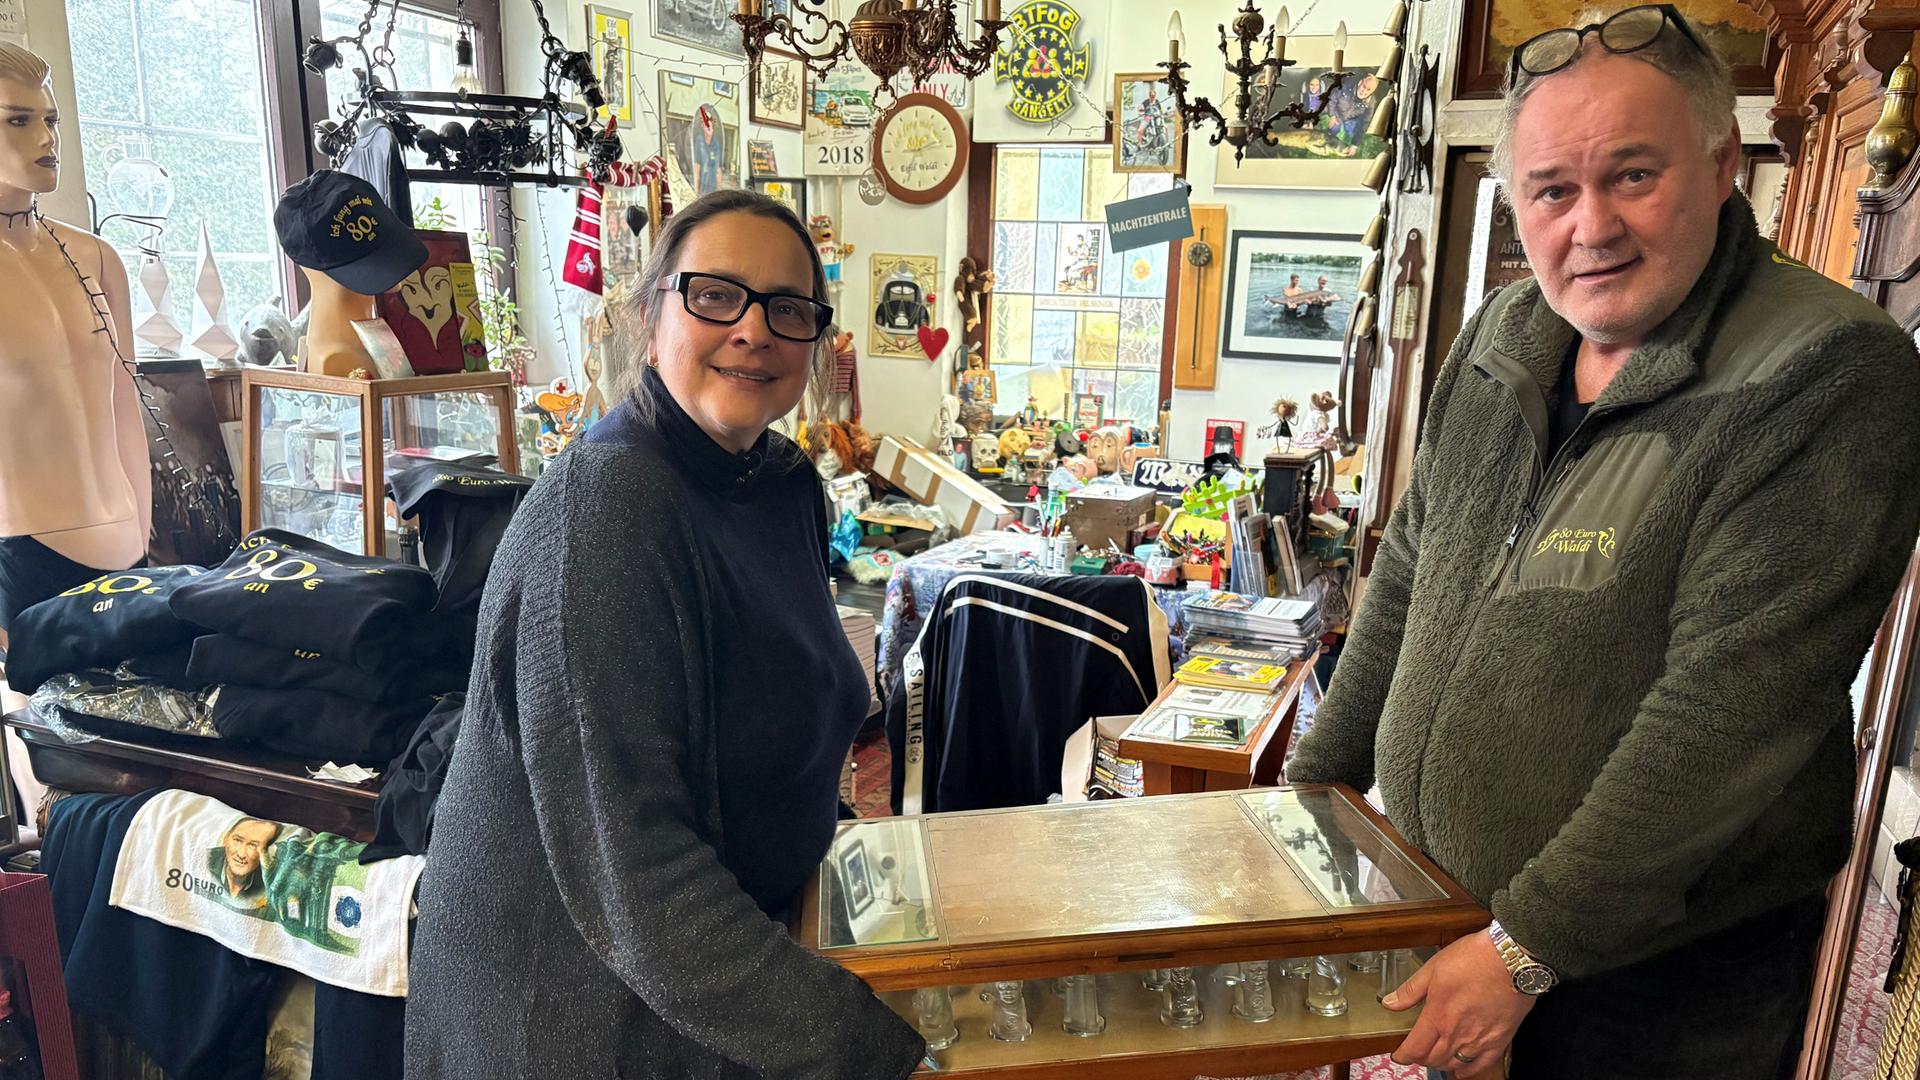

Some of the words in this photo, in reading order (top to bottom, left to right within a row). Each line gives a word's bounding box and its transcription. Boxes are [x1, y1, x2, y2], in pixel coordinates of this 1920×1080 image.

[818, 146, 864, 165] 2018
[1111, 207, 1187, 234] MACHTZENTRALE
[1501, 261, 1519, 269] MIT
[458, 475, 490, 485] Euro
[1574, 528, 1597, 539] Euro
[1554, 540, 1593, 553] Waldi
[243, 581, 271, 594] an
[92, 596, 114, 613] an
[909, 668, 924, 745] SAILING
